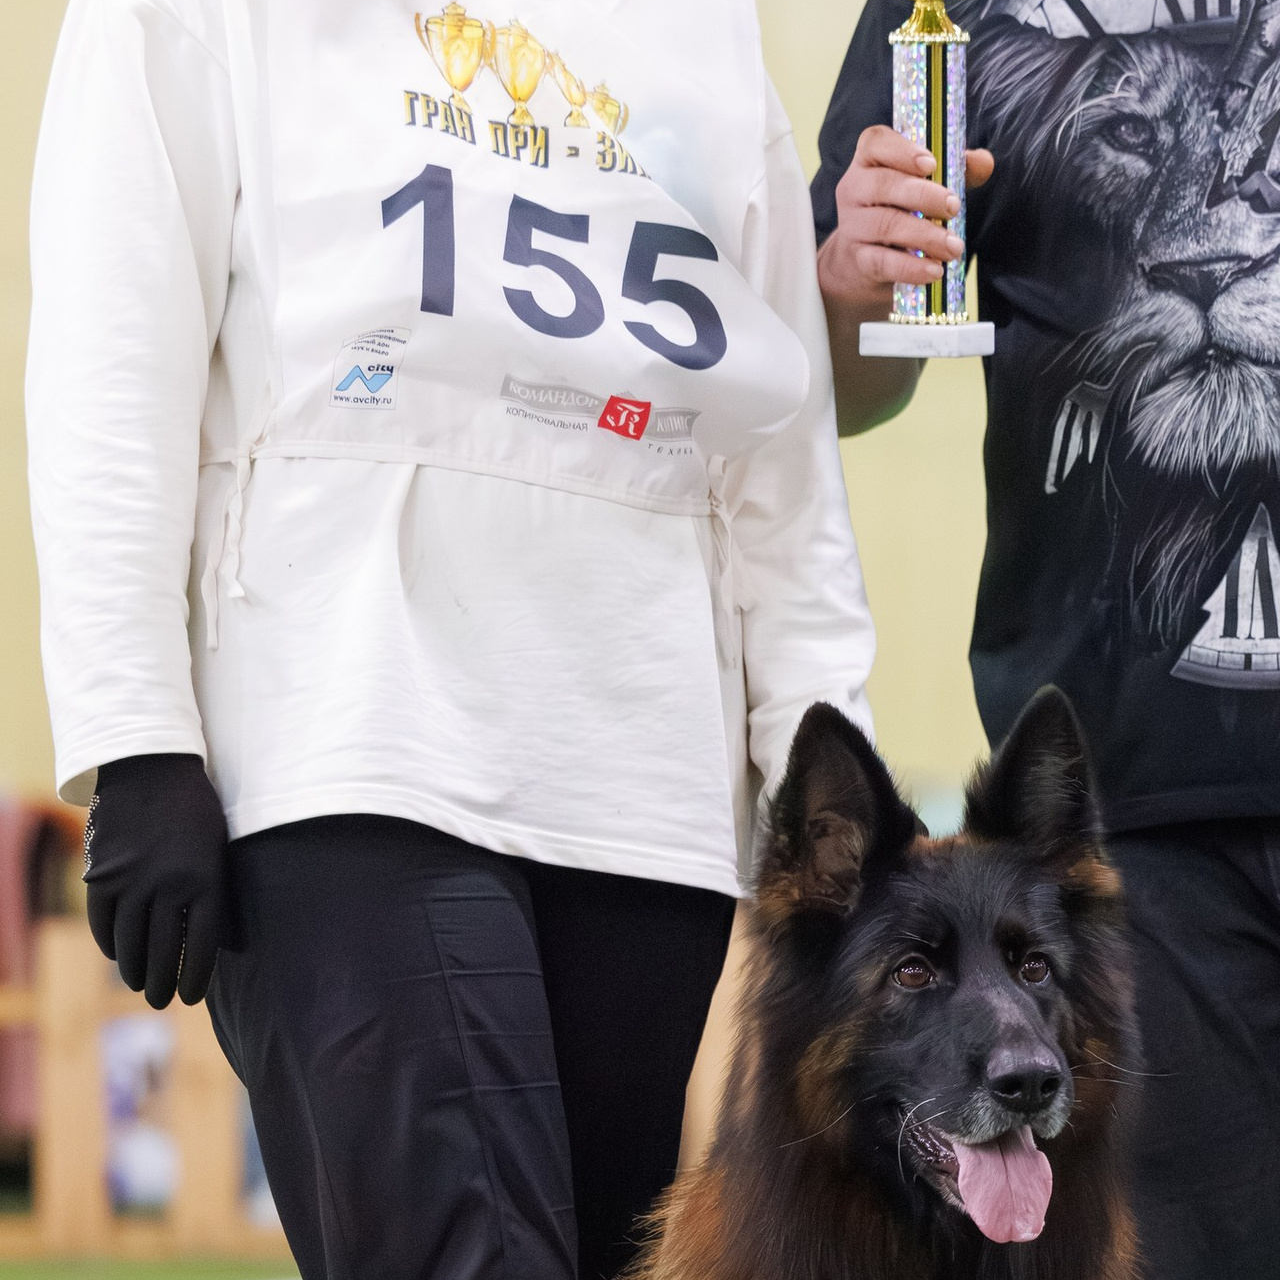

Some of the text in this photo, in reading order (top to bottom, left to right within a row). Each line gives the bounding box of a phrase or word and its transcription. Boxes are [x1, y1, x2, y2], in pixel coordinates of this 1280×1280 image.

[404, 90, 477, 145] ГРАН
[488, 120, 550, 169] ПРИ
[381, 164, 727, 371] 155
[367, 363, 394, 374] city
[333, 395, 392, 405] www.avcity.ru
[506, 406, 589, 432] КОПИРОВАЛЬНАЯ
